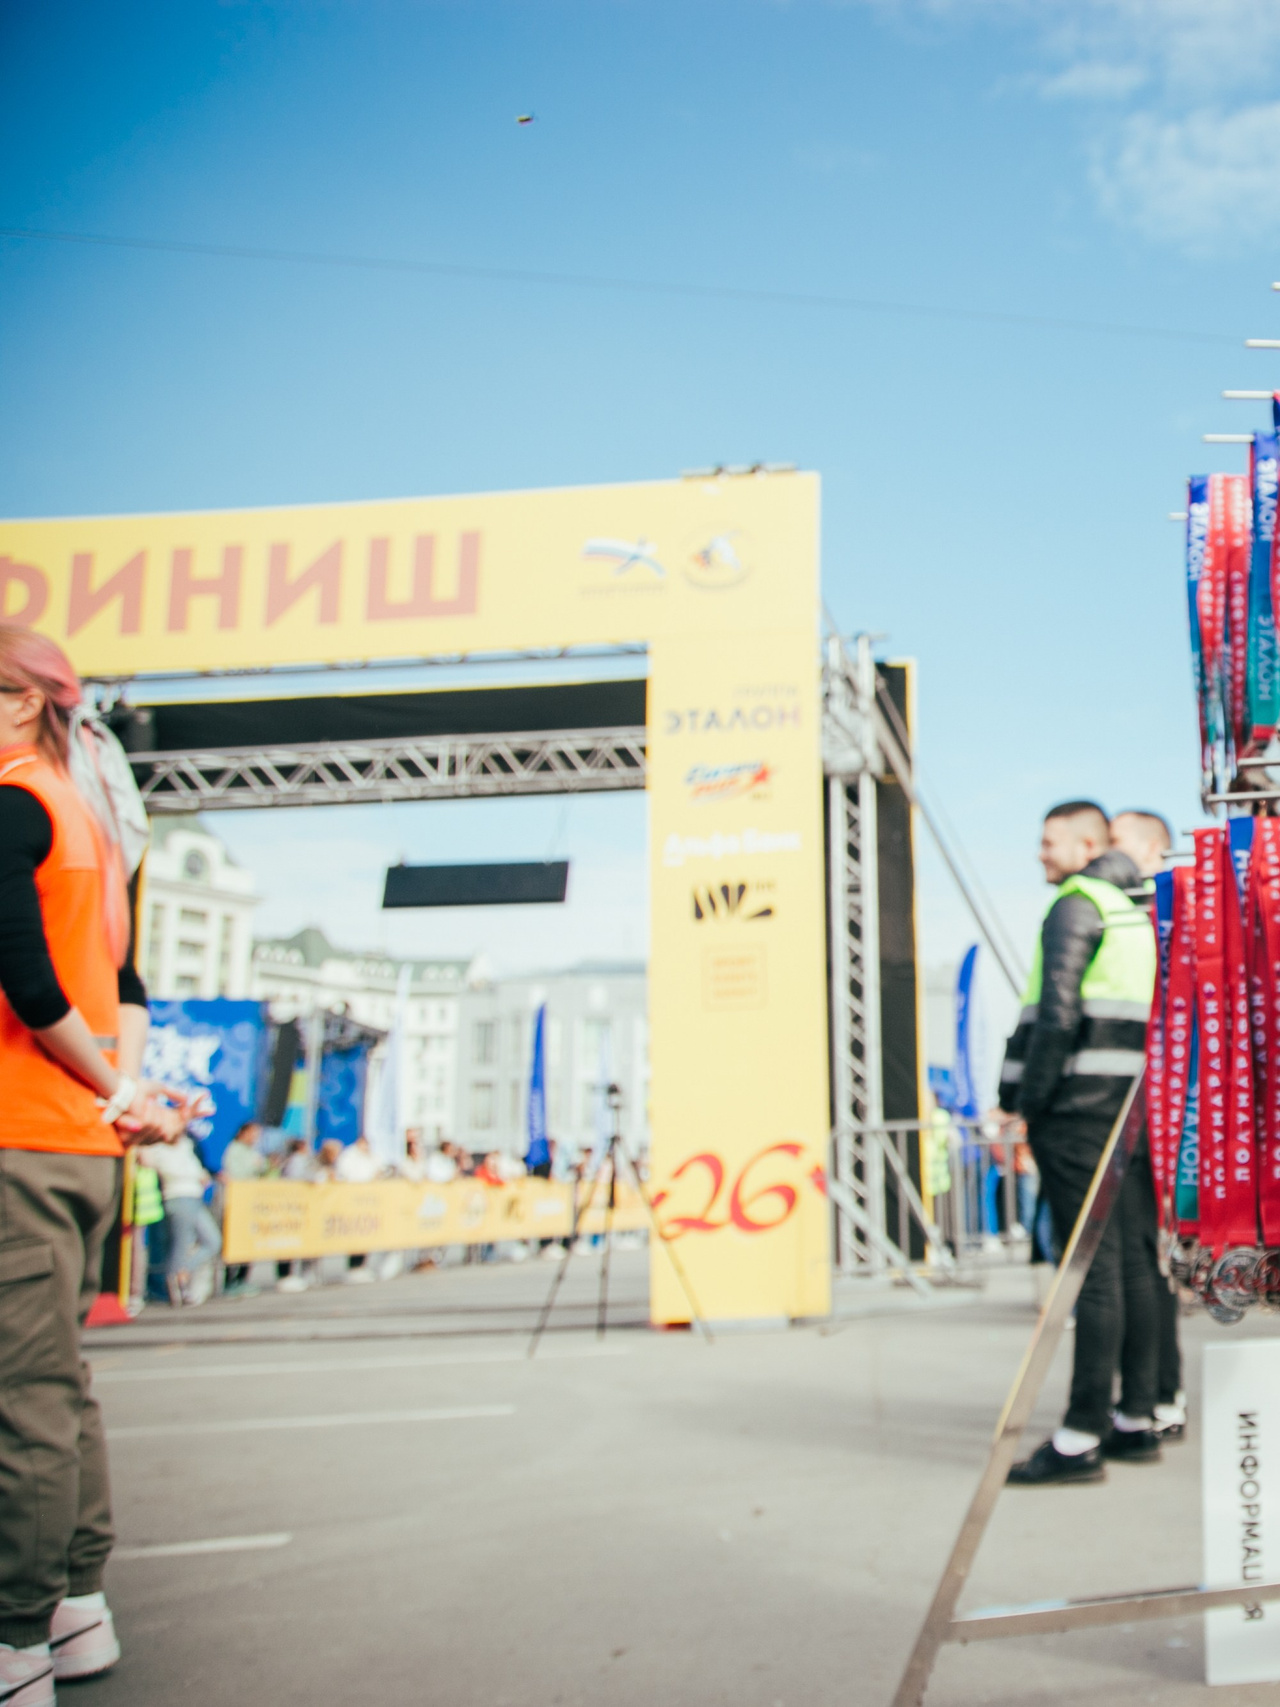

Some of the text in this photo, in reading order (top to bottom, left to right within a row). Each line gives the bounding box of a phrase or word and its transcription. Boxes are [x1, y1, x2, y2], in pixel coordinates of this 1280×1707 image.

[1189, 502, 1209, 581] ЭТАЛОН
[1256, 458, 1279, 542] ЭТАЛОН
[1258, 613, 1276, 701] ЭТАЛОН
[664, 705, 801, 734] ЭТАЛОН
[660, 1142, 805, 1240] 26
[1236, 1410, 1264, 1621] ИНФОРМАЦЯ
